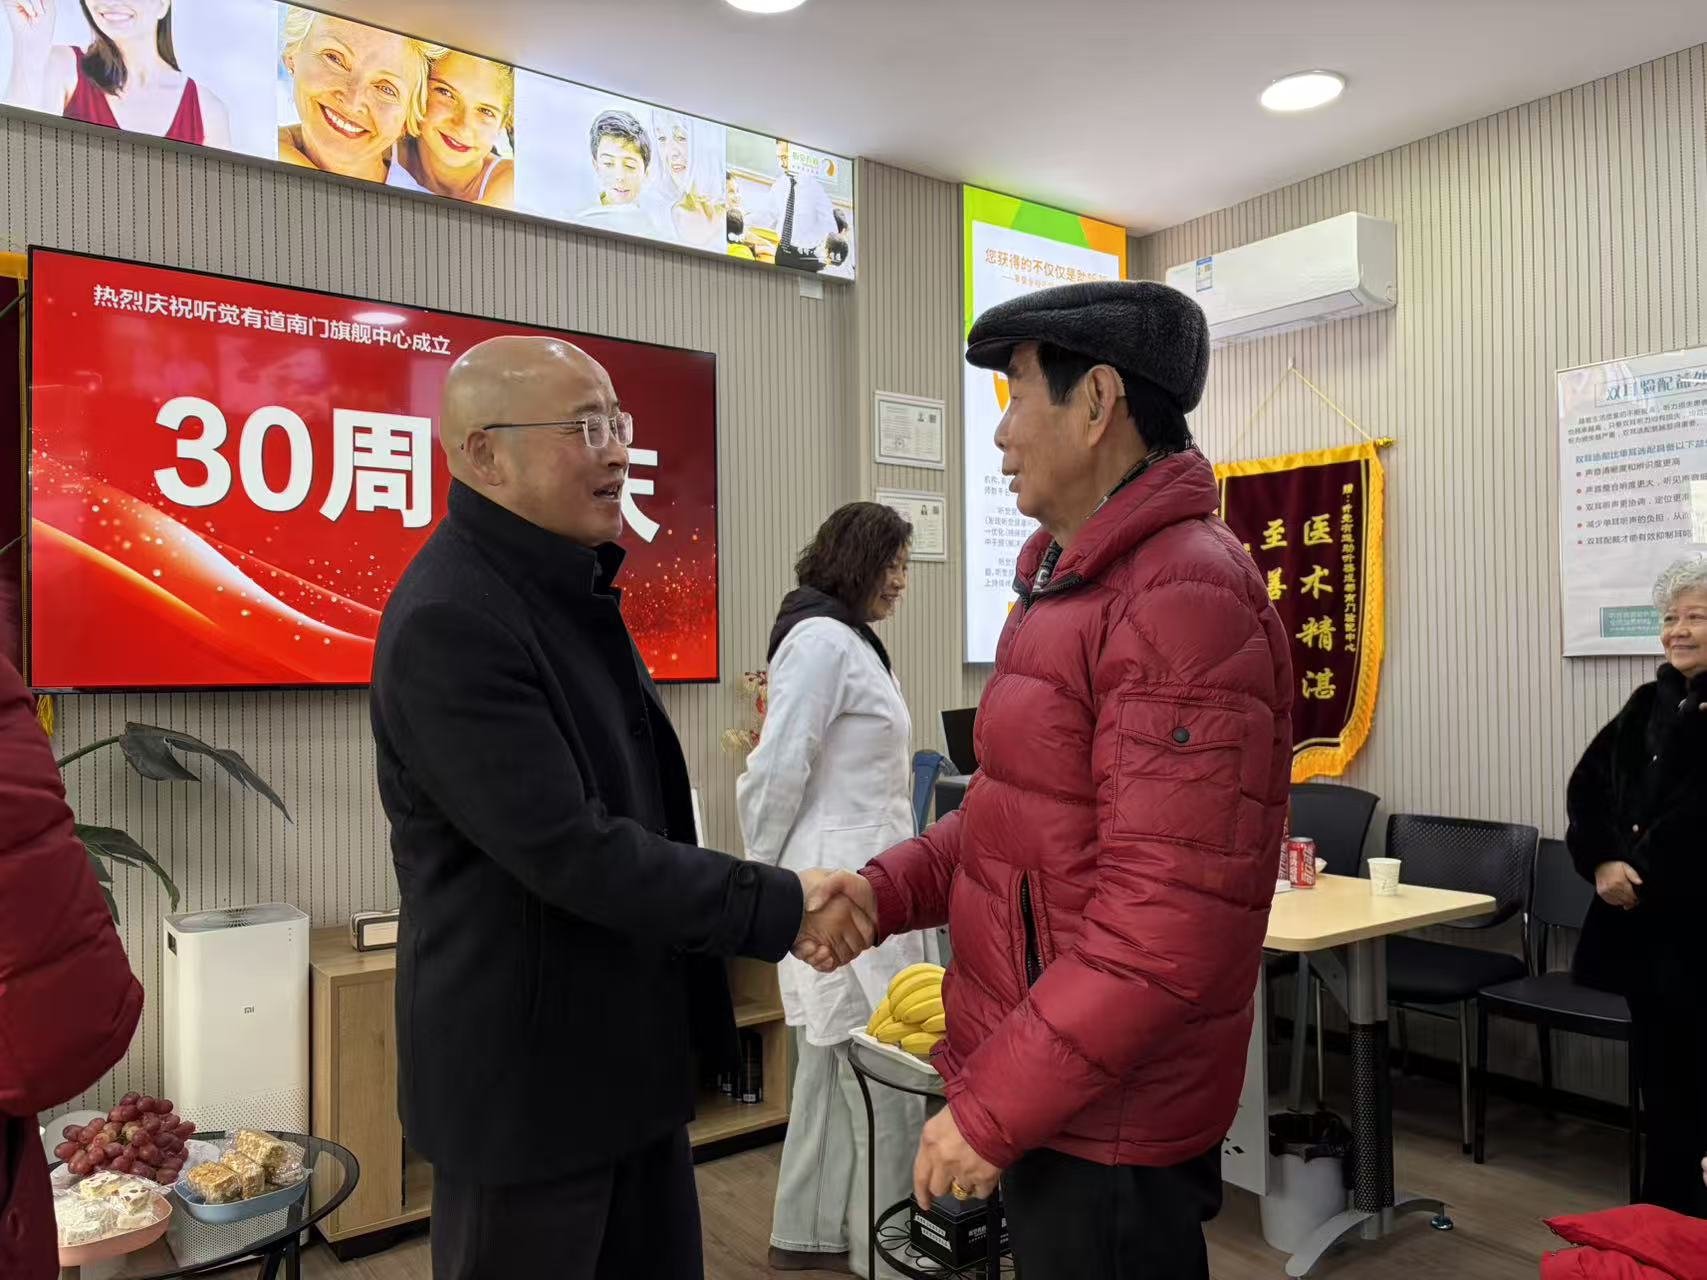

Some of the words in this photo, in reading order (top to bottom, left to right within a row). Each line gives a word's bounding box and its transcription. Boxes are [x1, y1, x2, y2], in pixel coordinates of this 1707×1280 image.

[93, 284, 451, 356] 热烈庆祝听觉有道南门旗舰中心成立
[1295, 513, 1337, 700] 医术精湛
